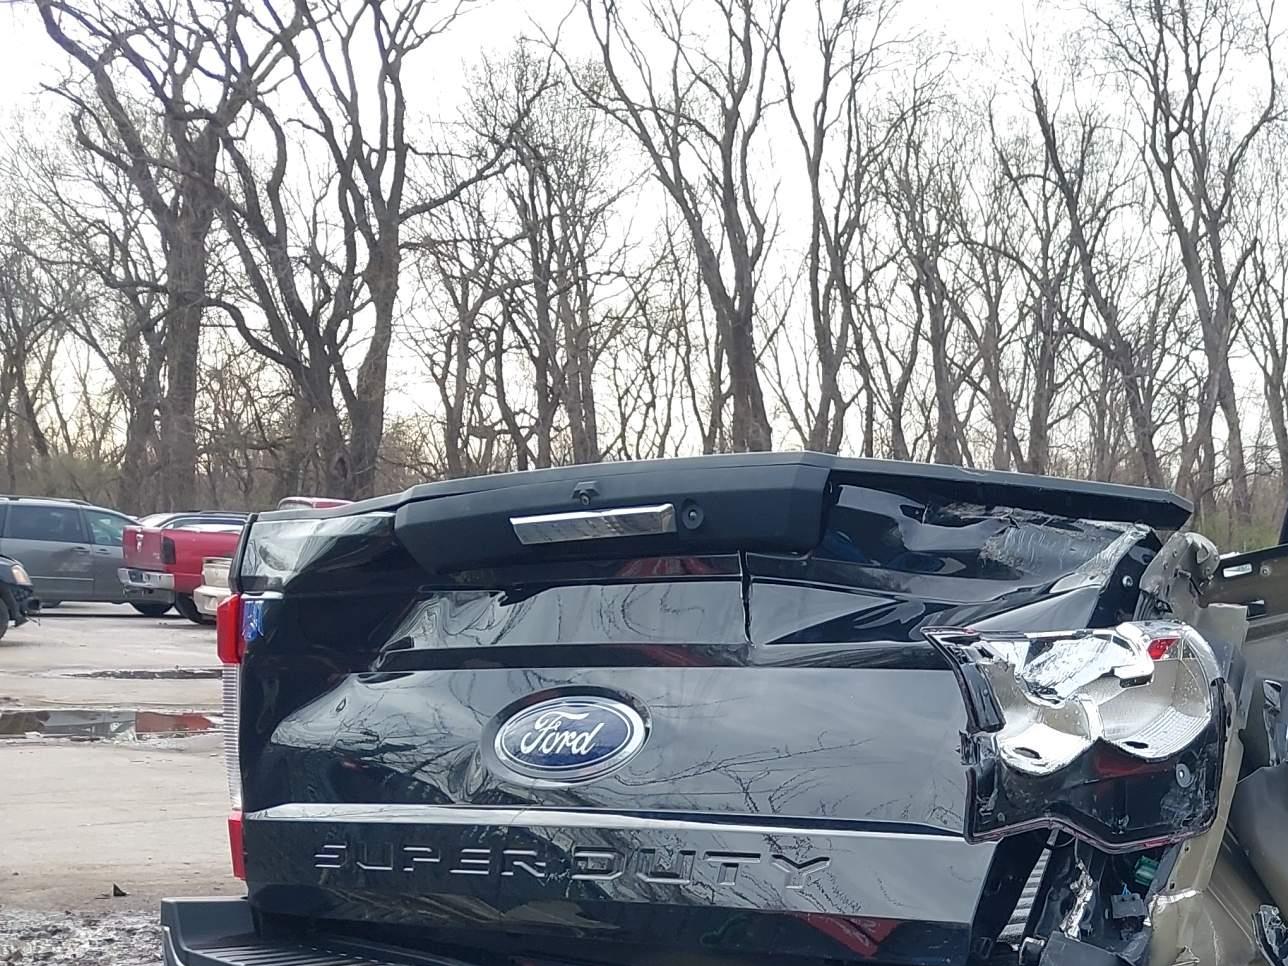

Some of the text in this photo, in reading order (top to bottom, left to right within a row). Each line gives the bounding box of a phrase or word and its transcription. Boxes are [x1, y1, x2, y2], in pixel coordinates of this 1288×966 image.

[520, 710, 605, 755] Ford
[314, 842, 831, 889] SUPER DUTY
